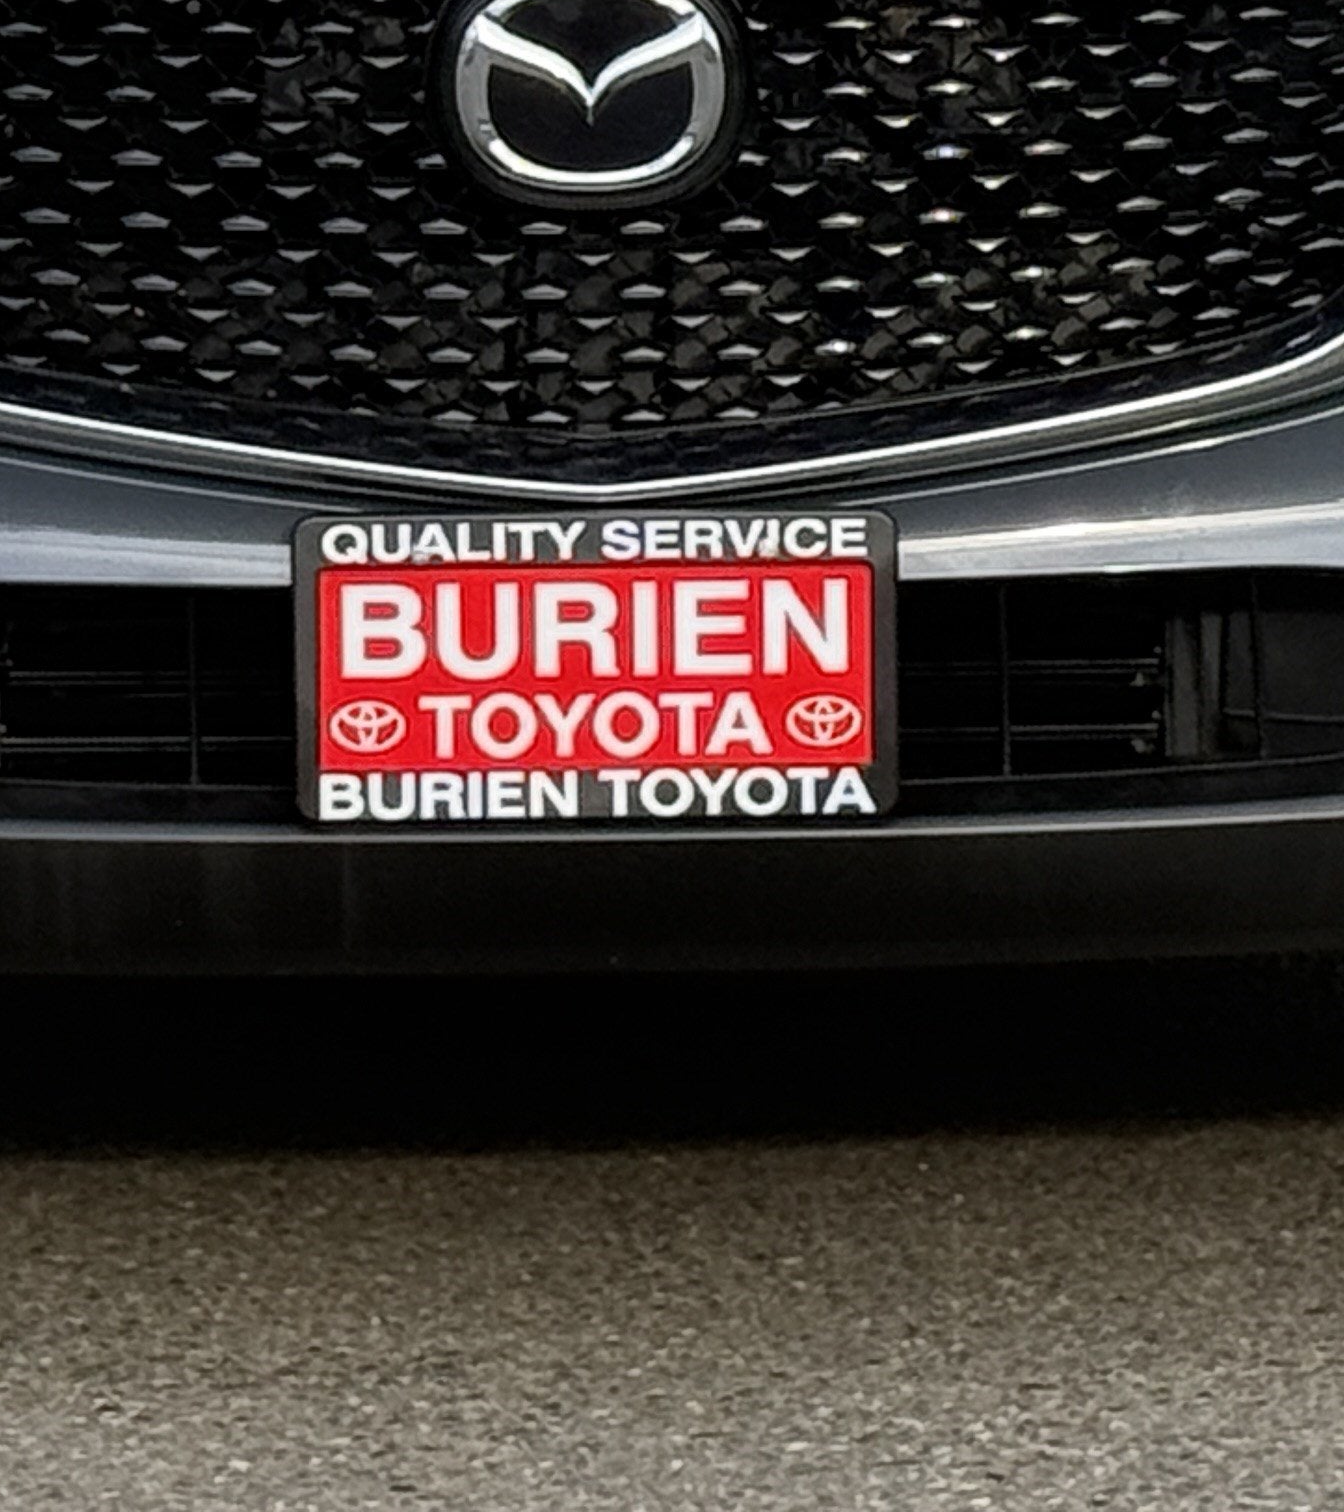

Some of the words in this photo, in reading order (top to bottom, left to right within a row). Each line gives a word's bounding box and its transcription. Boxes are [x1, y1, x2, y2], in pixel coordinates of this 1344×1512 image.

[320, 521, 587, 564] QUALITY
[601, 518, 868, 560] SERVICE
[340, 577, 850, 681] BURIEN
[418, 691, 774, 760] TOYOTA
[318, 771, 585, 822] BURIEN
[598, 767, 877, 818] TOYOTA
